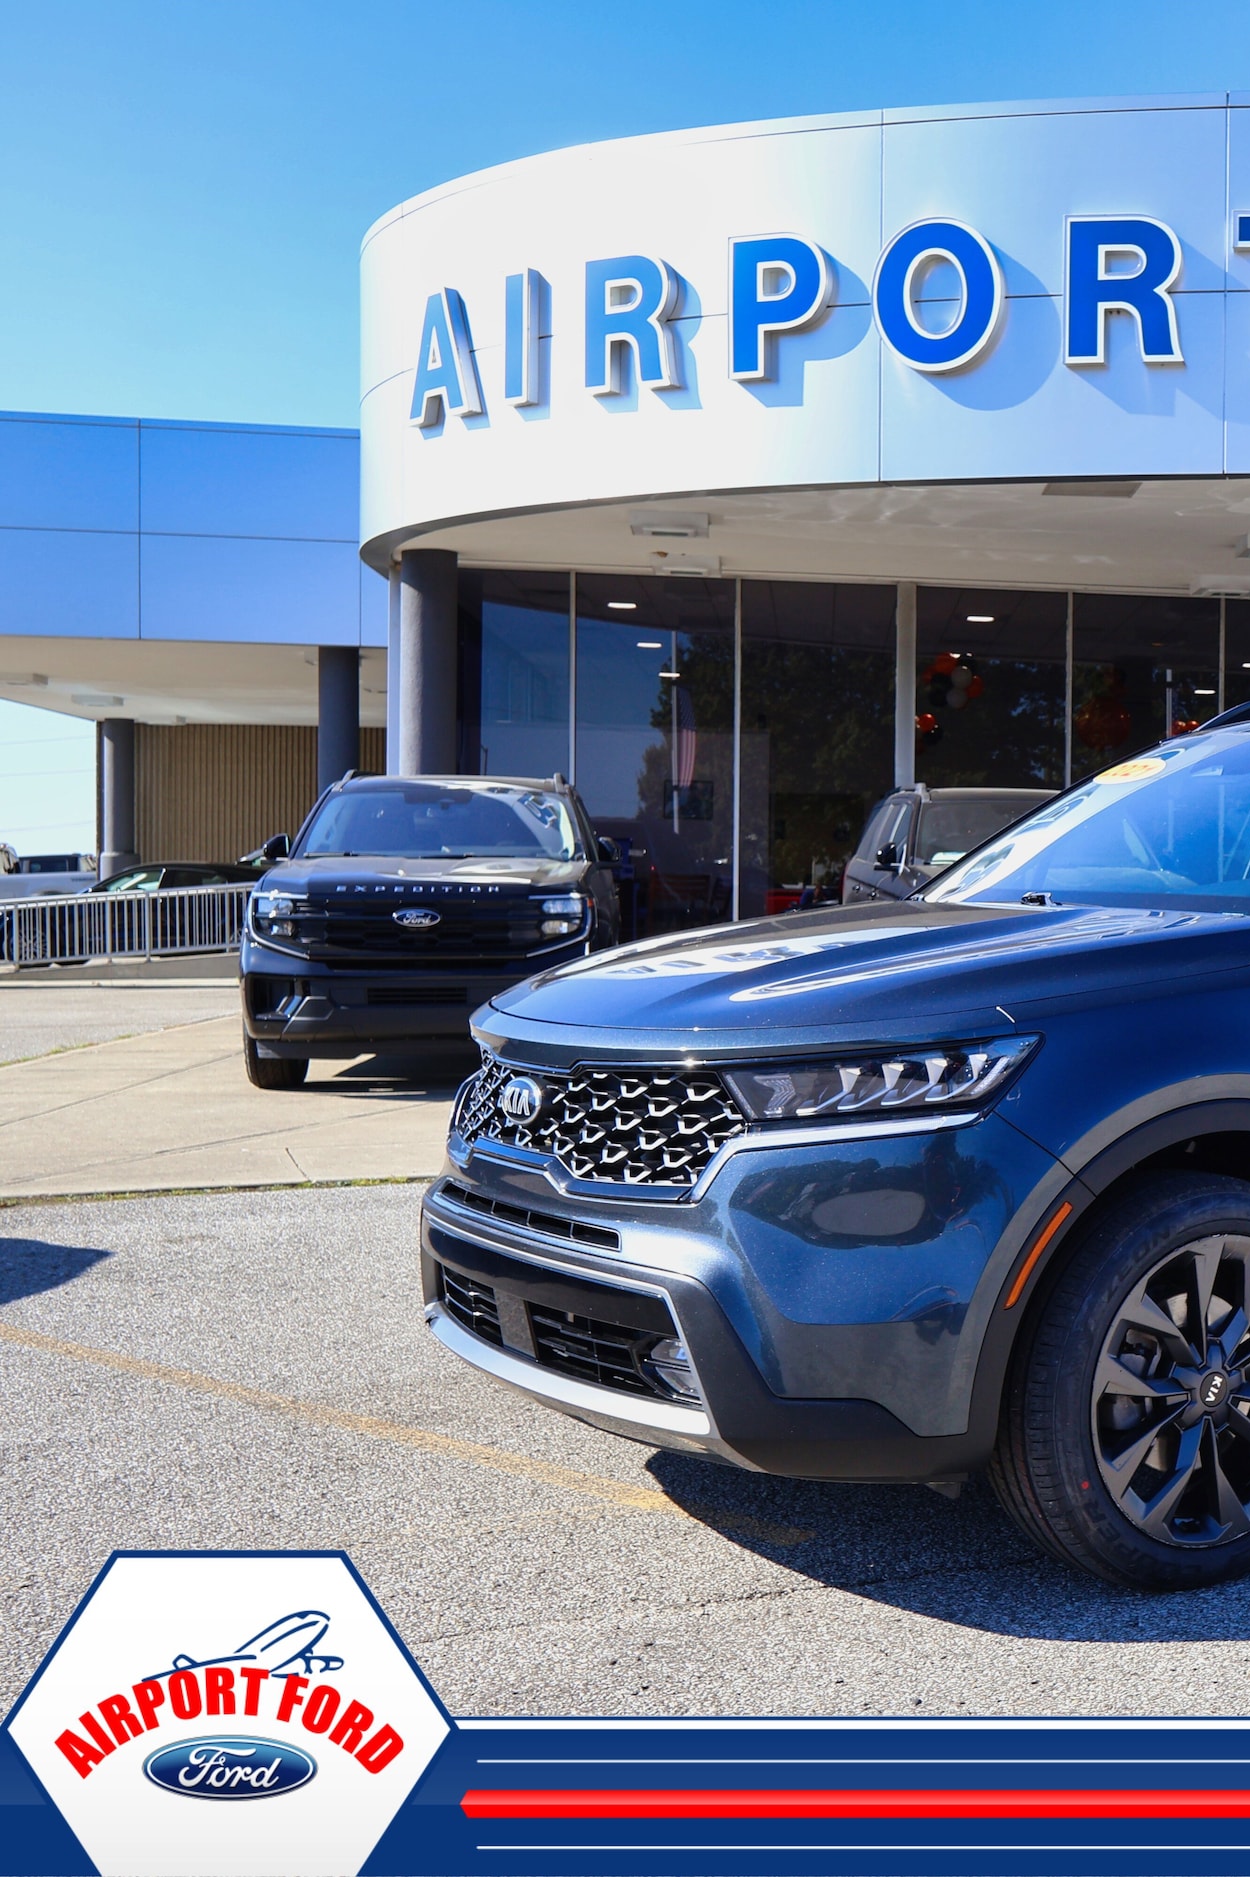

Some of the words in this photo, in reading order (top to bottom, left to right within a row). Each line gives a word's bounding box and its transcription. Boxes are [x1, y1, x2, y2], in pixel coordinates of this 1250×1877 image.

[336, 885, 499, 893] EXPEDITION
[402, 911, 432, 925] Ford
[503, 1087, 530, 1115] KIA
[1205, 1375, 1223, 1402] KIA
